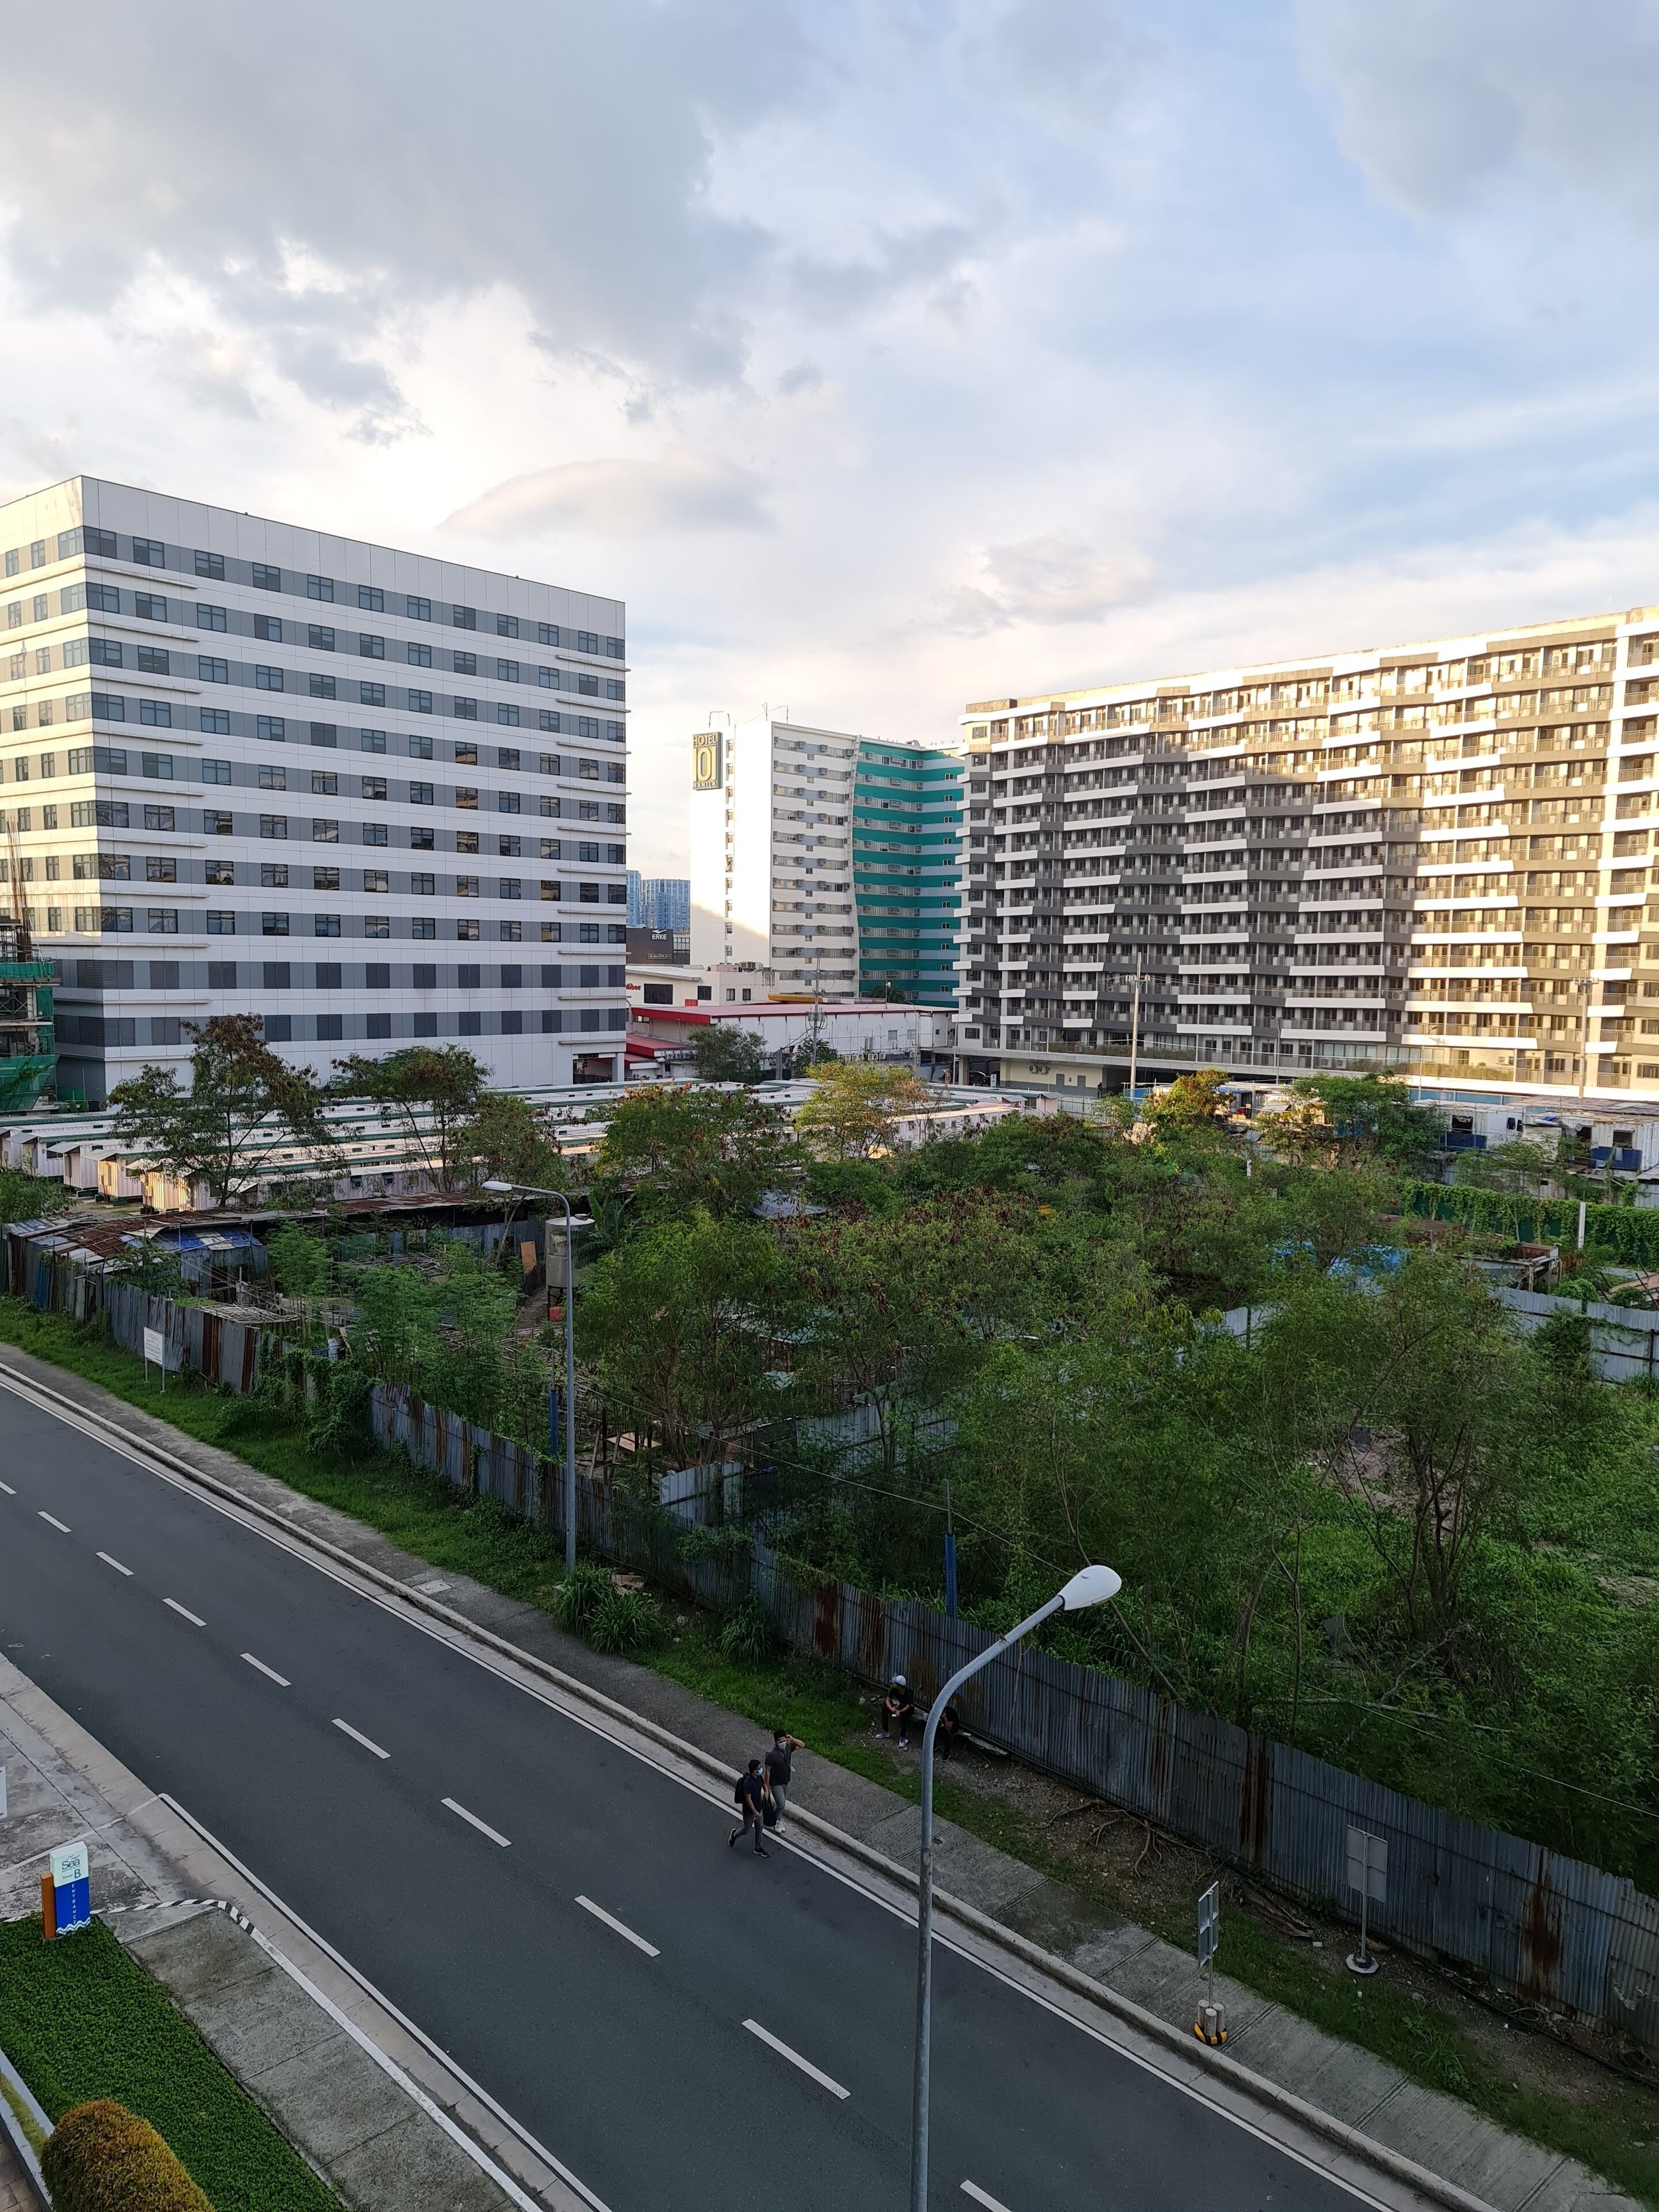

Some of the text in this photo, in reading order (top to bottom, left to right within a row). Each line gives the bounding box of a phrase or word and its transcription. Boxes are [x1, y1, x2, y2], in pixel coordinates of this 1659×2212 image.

[693, 734, 717, 745] HOTEL
[693, 746, 717, 782] 101
[62, 1859, 80, 1870] Sea
[74, 1869, 81, 1878] B
